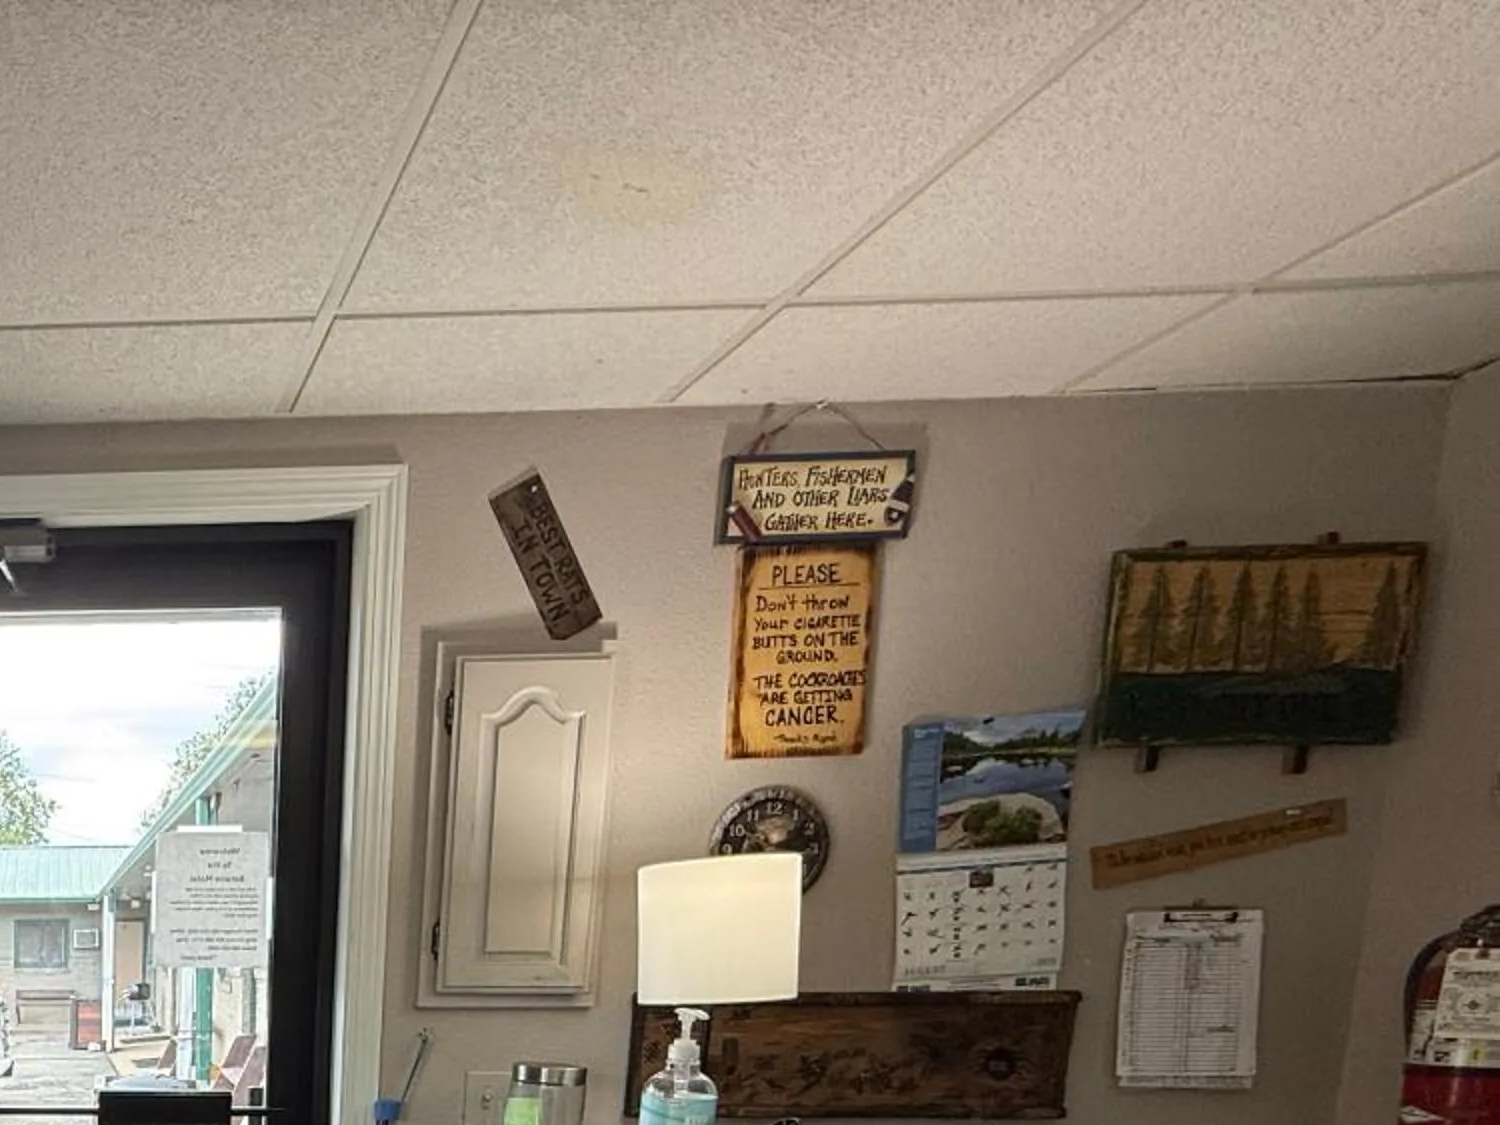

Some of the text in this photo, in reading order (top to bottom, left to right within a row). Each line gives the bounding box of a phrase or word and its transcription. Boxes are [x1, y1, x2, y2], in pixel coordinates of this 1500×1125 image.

[806, 465, 887, 487] FISHERMEN
[752, 486, 890, 509] AND OTHER LIARS
[764, 511, 819, 531] GATHER
[511, 518, 541, 555] IN
[771, 562, 841, 587] PLEASE
[751, 631, 860, 650] BUTTS ON THE
[753, 672, 783, 690] THE
[758, 688, 853, 707] ARE GETTING
[766, 801, 783, 815] 12
[729, 823, 746, 837] 10
